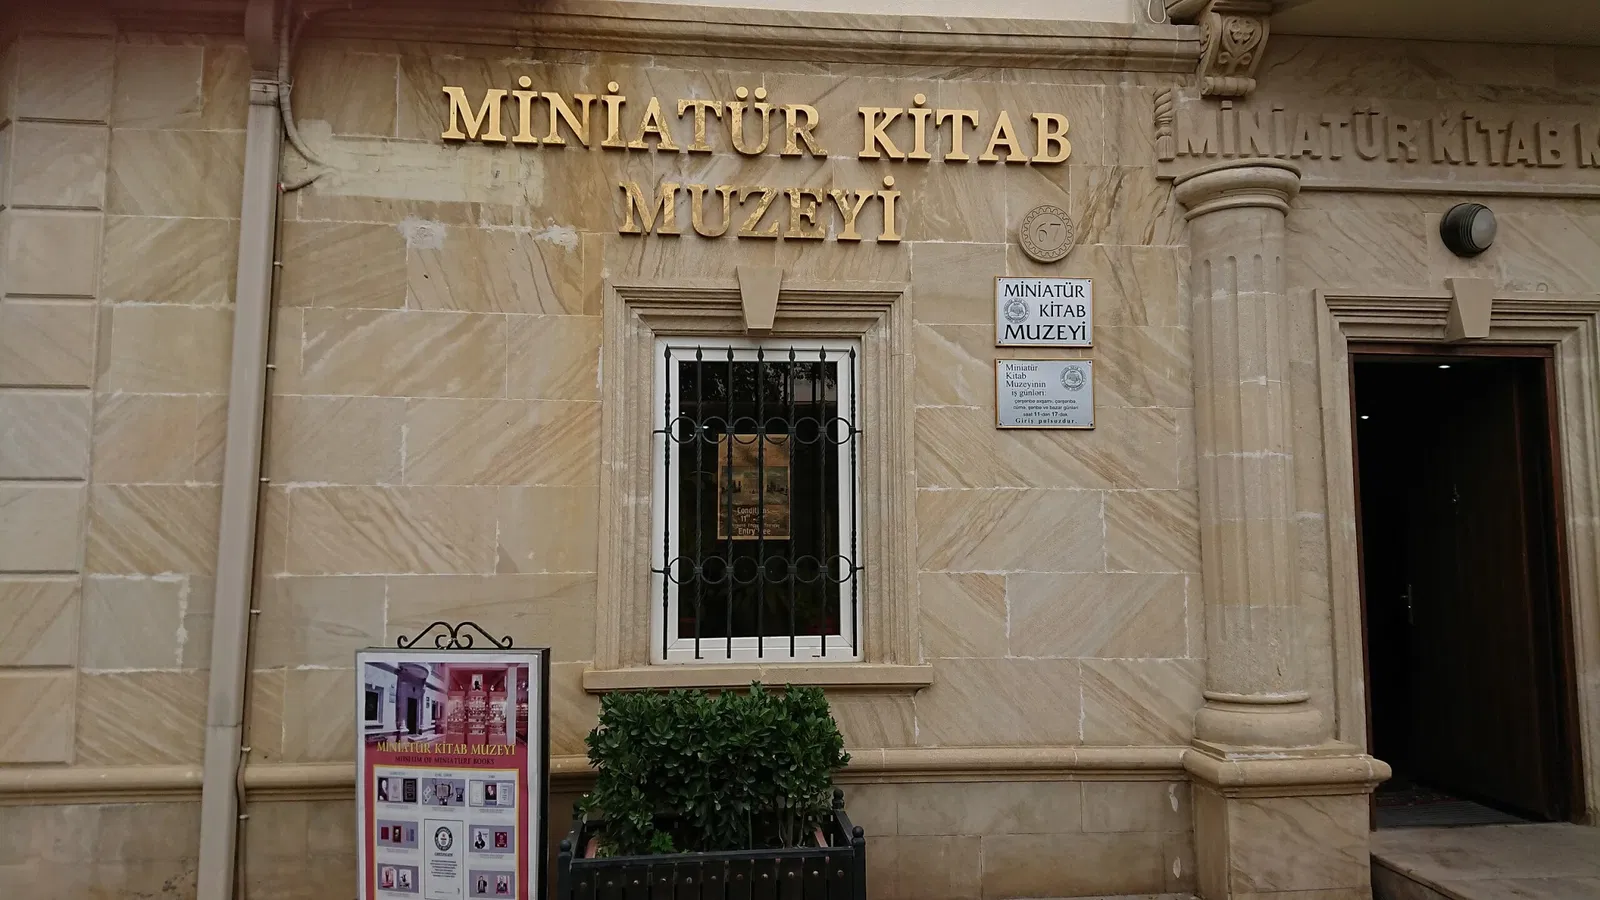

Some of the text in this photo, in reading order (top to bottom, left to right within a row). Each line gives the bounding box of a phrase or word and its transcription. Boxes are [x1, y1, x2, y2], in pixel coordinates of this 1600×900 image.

[441, 76, 1073, 164] MİNİATÜR KİTAB
[1176, 99, 1419, 163] MİNİATÜR
[1428, 109, 1566, 169] KİTAB
[618, 175, 902, 242] MUZEYİ
[1035, 223, 1062, 243] 67
[1004, 281, 1085, 298] MİNİATÜR
[1039, 301, 1086, 318] KİTAB
[1004, 321, 1086, 340] MUZEYİ
[1005, 372, 1027, 380] Kitab
[1005, 380, 1047, 389] Muzeyinin
[434, 741, 468, 754] KİTAB
